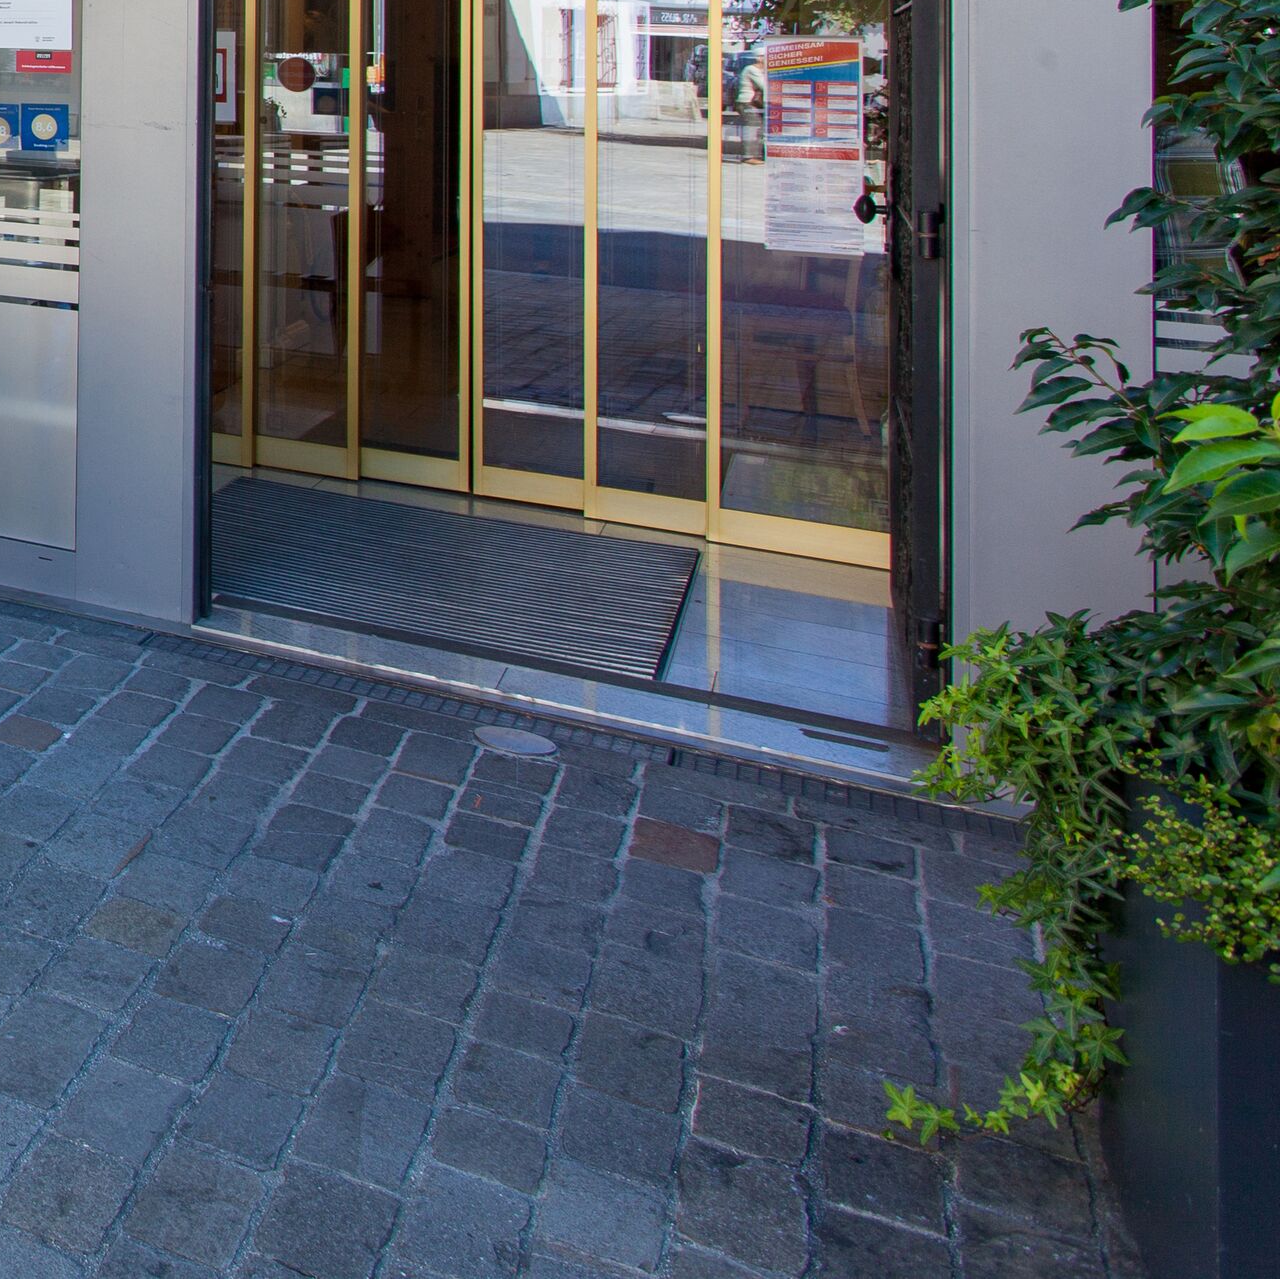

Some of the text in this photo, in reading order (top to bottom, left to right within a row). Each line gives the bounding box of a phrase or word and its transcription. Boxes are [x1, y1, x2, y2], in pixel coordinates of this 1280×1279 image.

[768, 41, 825, 53] GEMEINSAM
[768, 50, 803, 61] SICHER
[768, 56, 823, 68] GENIESSEN!
